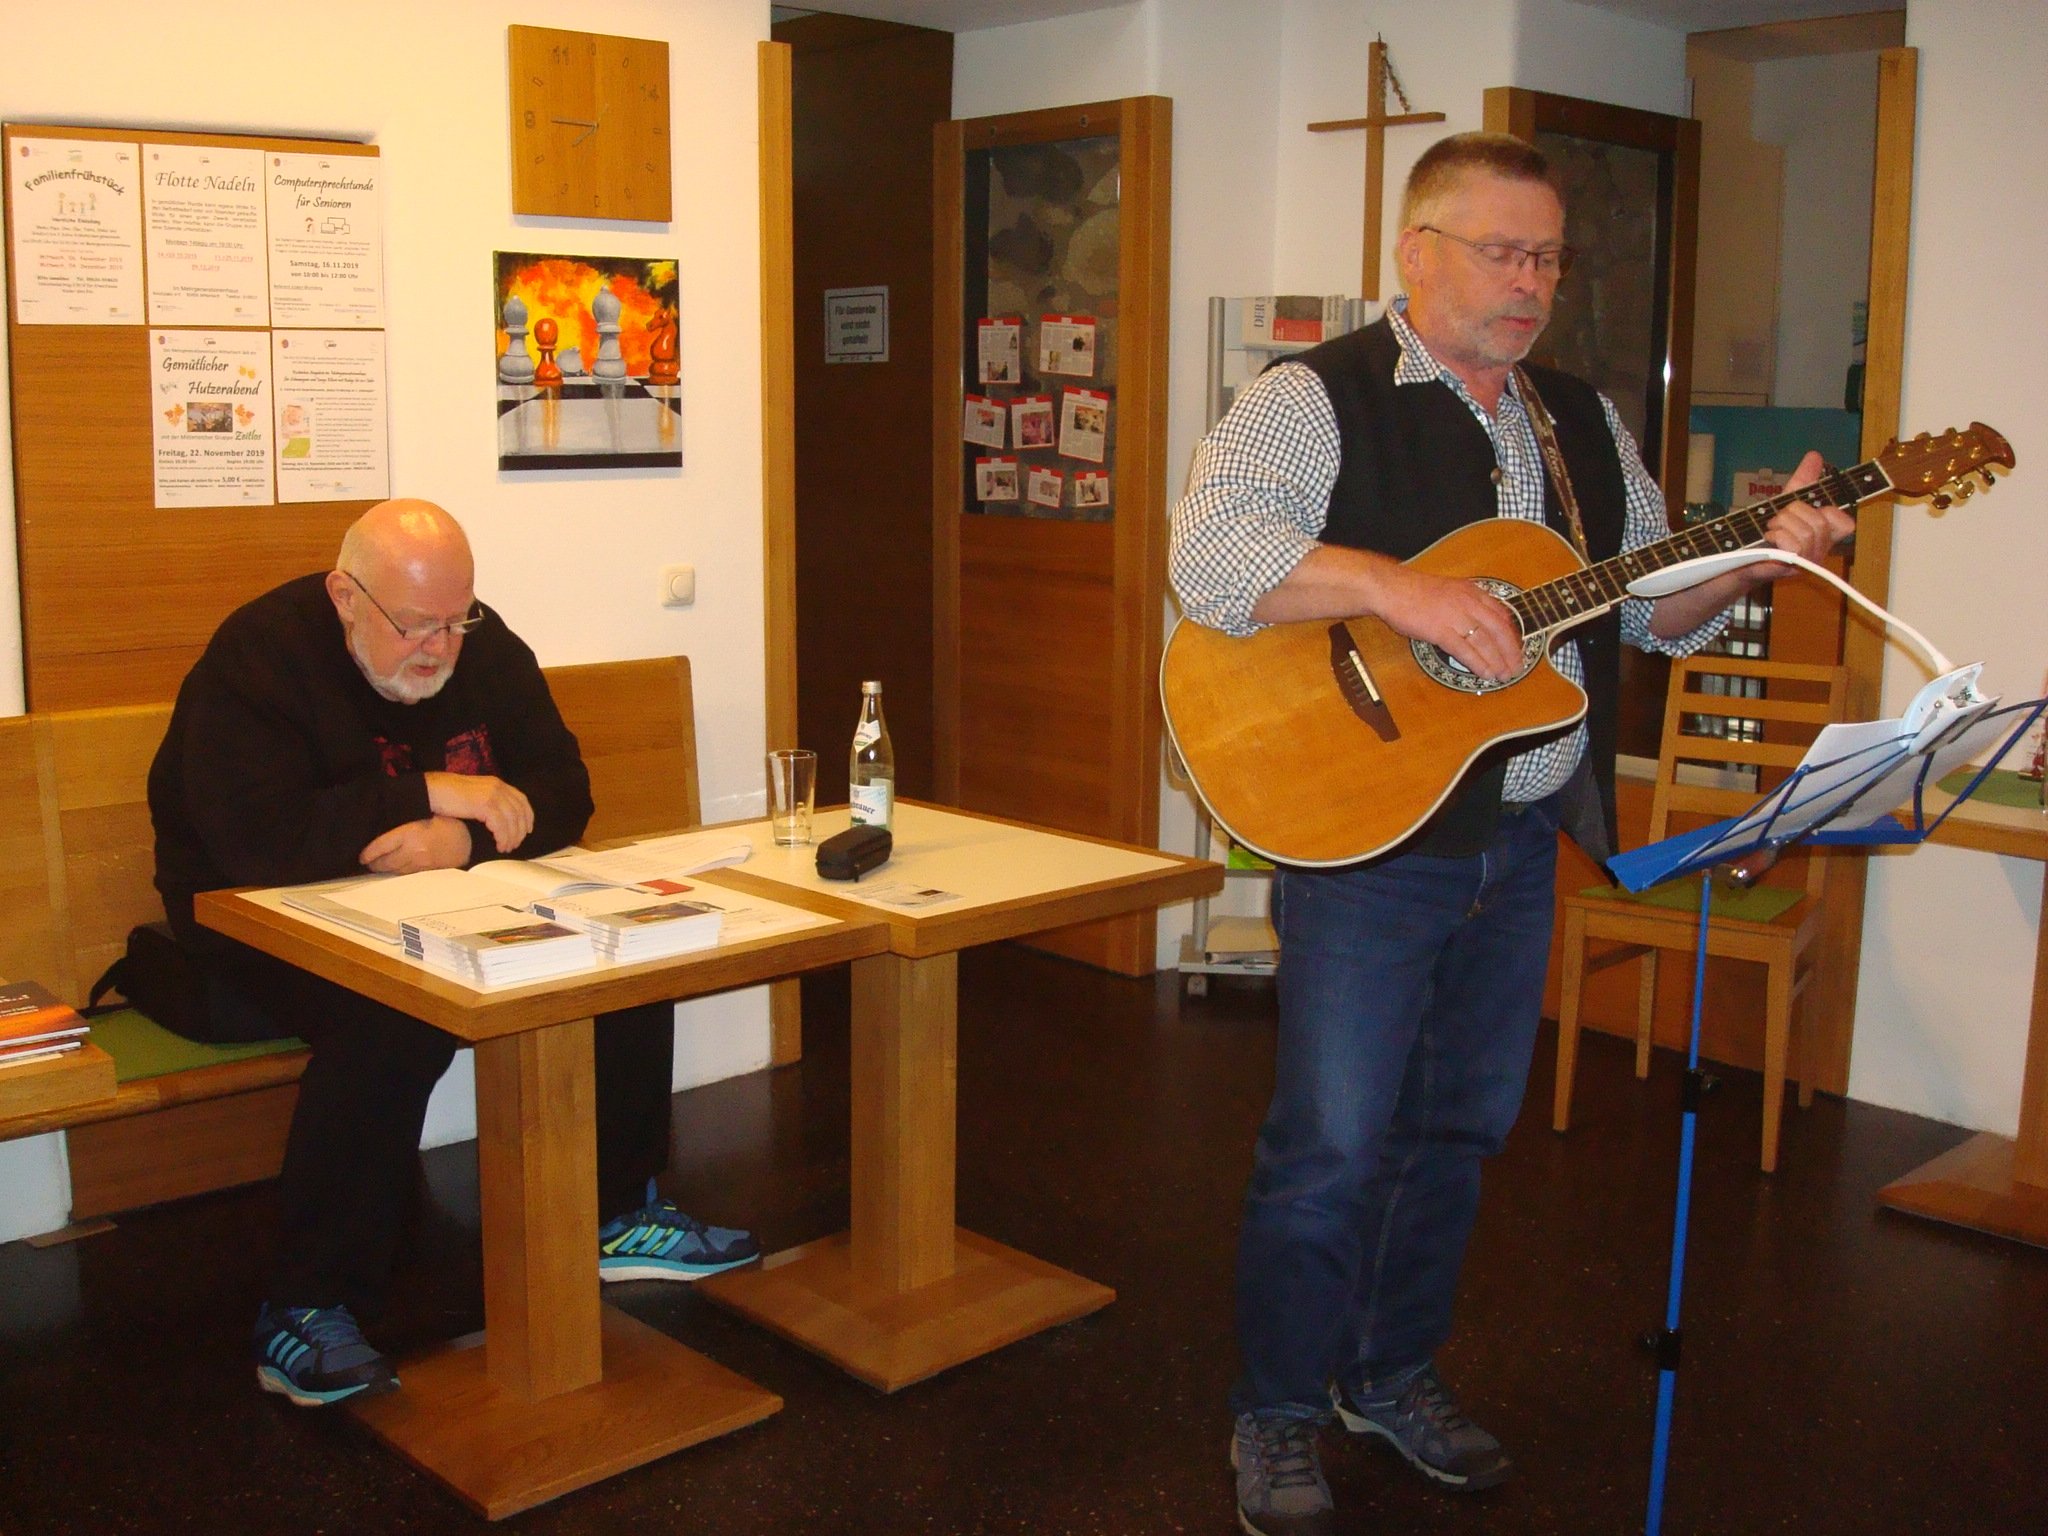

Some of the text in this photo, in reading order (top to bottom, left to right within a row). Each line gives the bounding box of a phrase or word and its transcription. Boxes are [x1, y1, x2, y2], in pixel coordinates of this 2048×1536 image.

[24, 168, 125, 196] Familienfrühstück
[155, 171, 256, 192] Flotte Nadeln
[274, 174, 374, 194] Computersprechstunde
[296, 194, 352, 209] für Senioren
[290, 260, 359, 269] Samstag, 16.11.2019
[1254, 303, 1265, 328] DER
[162, 355, 229, 372] Gemütlicher
[188, 380, 262, 396] Hutzerabend
[235, 429, 262, 441] Zeitlos
[158, 449, 188, 458] Freitag,
[190, 449, 202, 457] 22.
[204, 449, 244, 457] November
